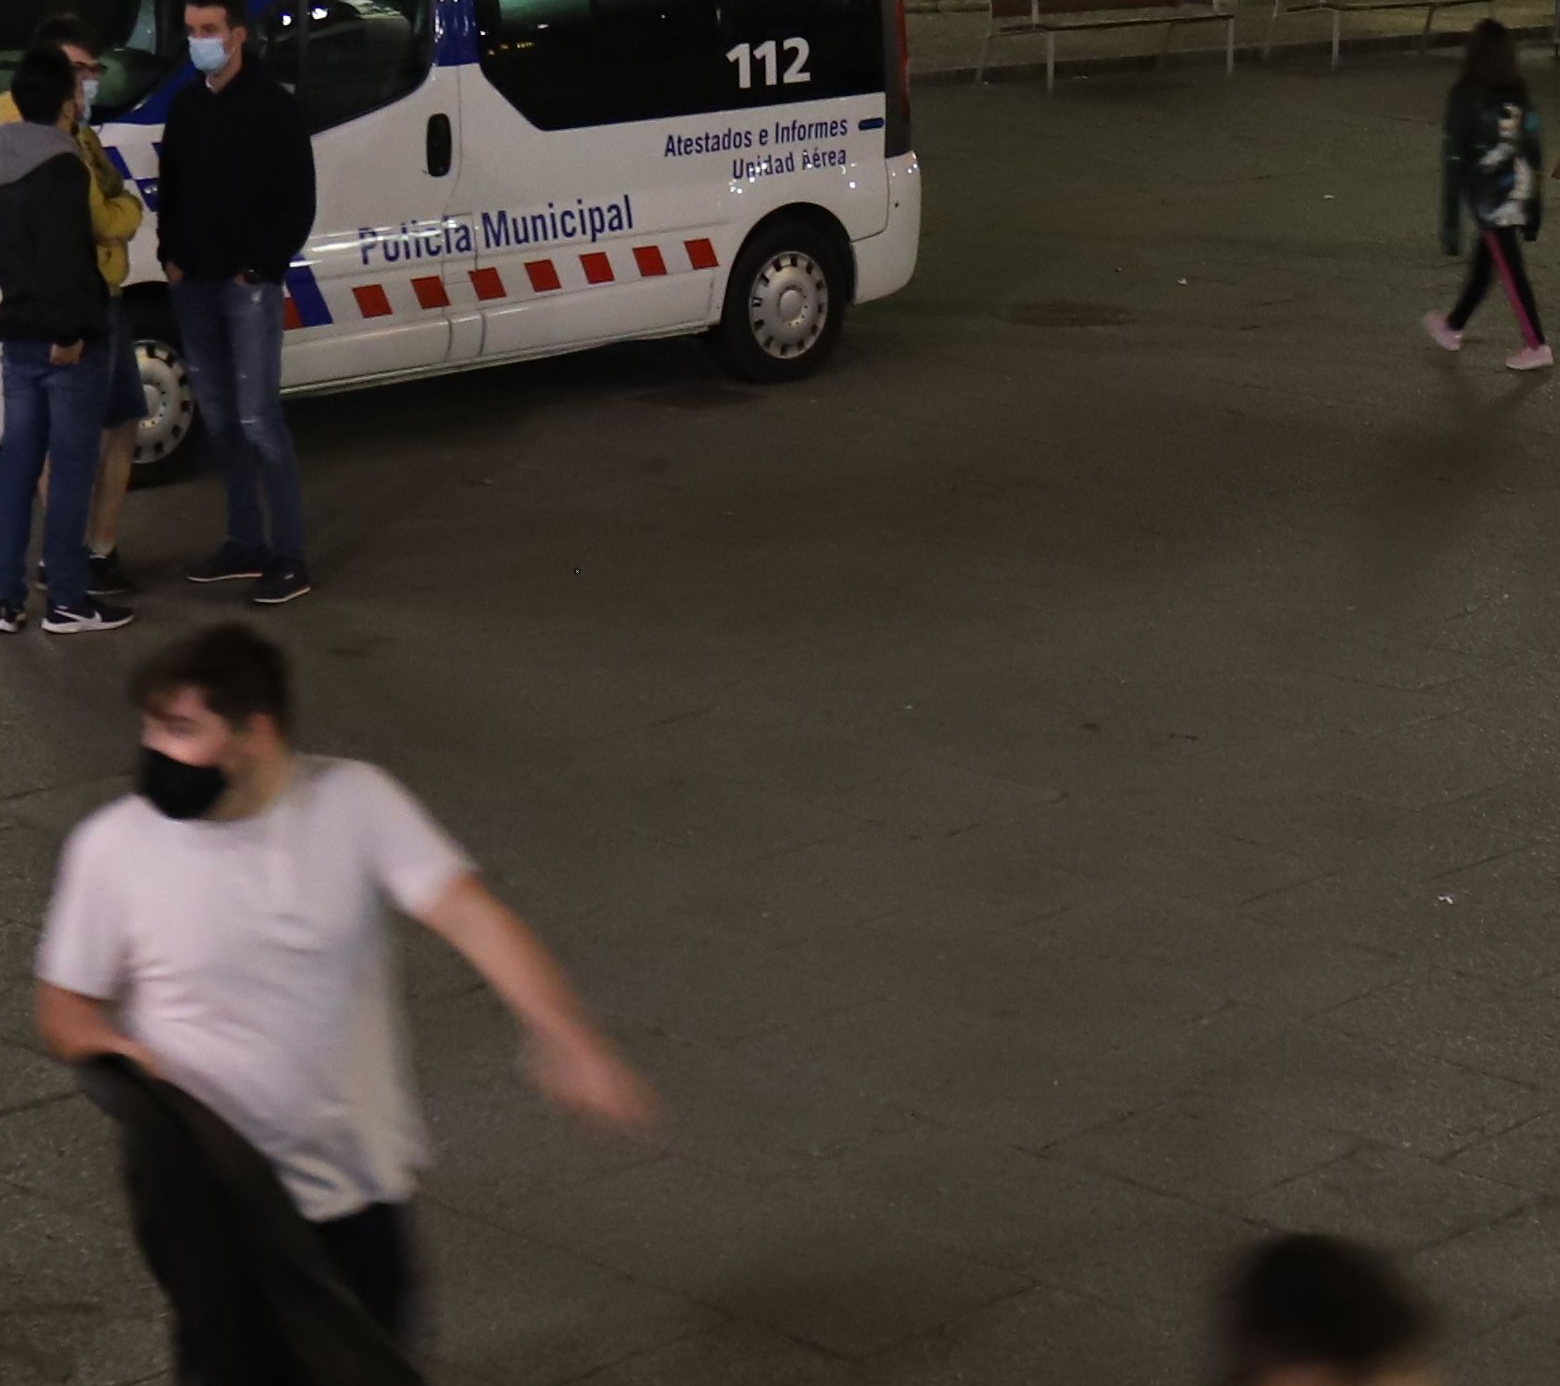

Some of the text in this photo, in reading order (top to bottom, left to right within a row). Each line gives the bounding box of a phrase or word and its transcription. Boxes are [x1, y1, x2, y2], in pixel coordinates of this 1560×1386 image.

[725, 36, 811, 89] 112
[664, 118, 848, 158] Atestados e Informes
[732, 146, 847, 180] Unidad Aérea
[358, 194, 634, 265] Policía Municipal
